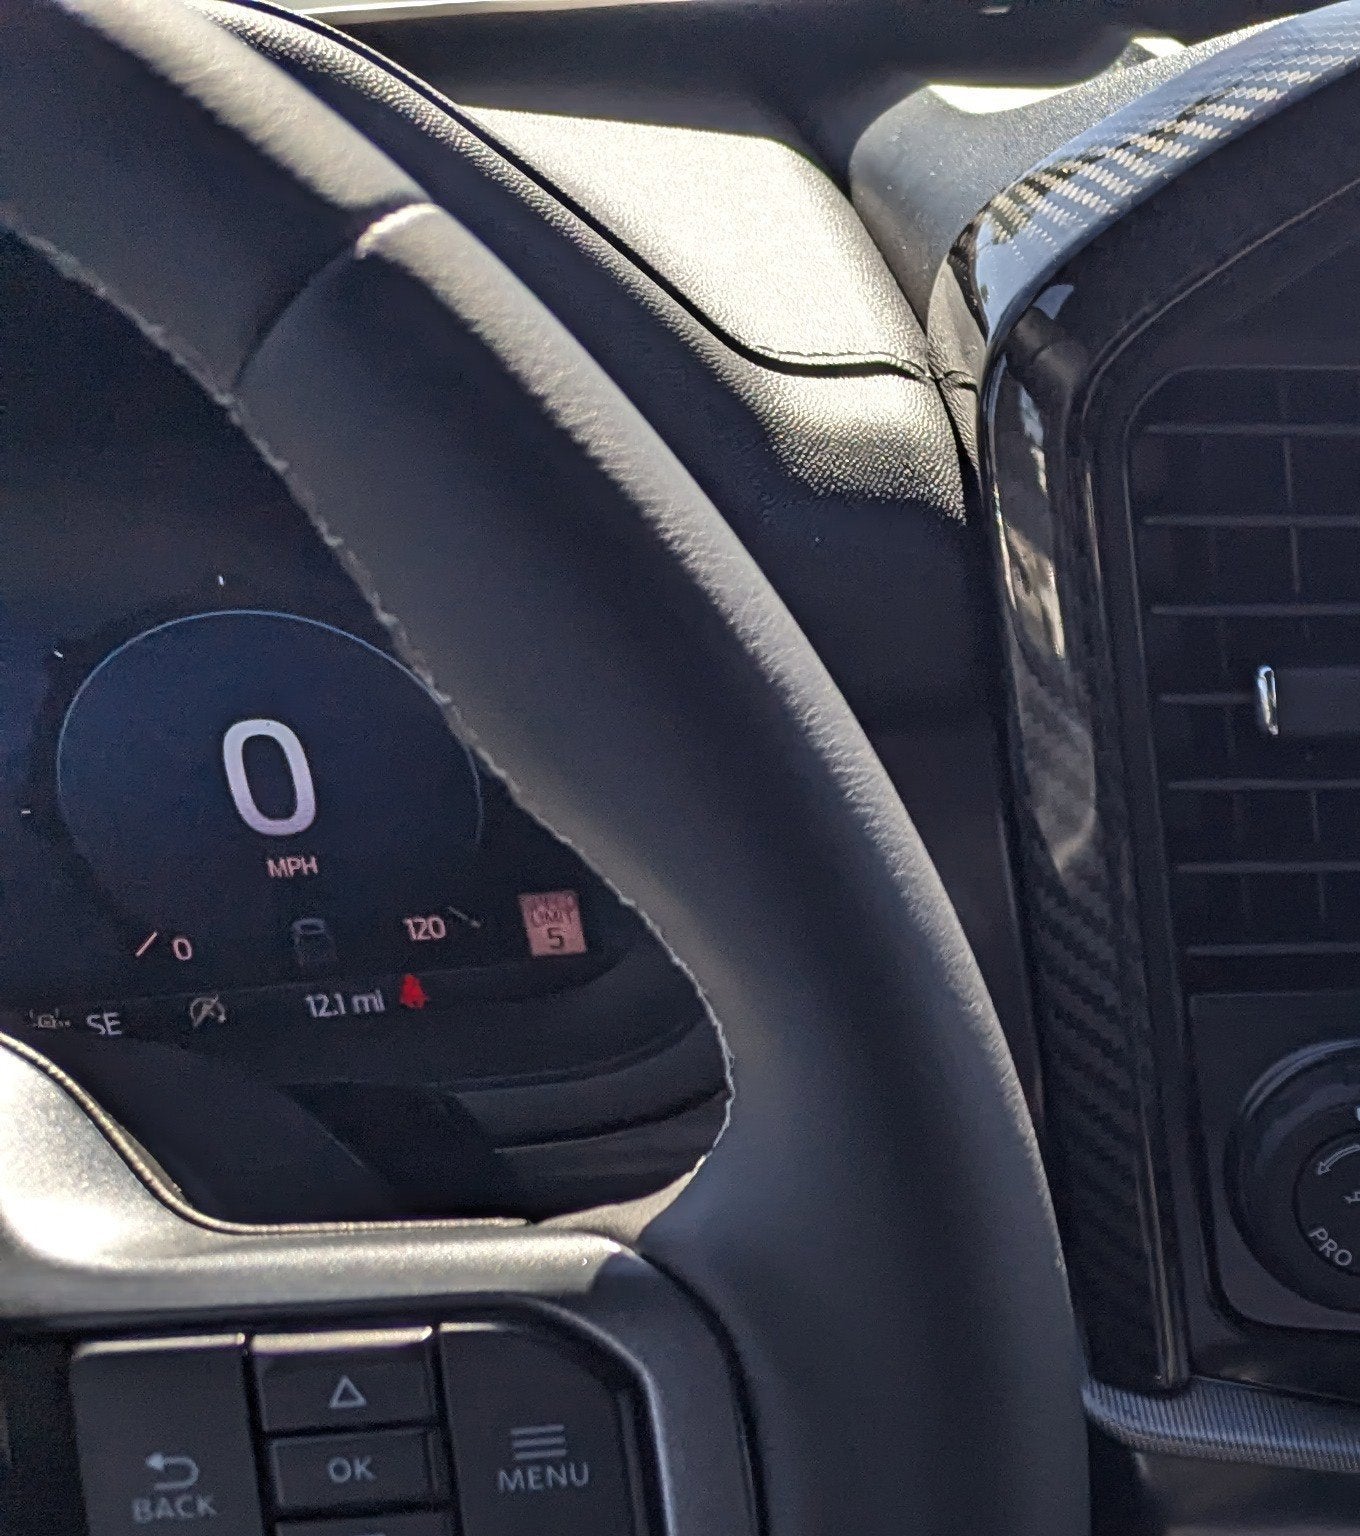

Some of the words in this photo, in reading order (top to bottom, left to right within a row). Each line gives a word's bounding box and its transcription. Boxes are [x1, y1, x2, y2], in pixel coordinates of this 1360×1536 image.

[222, 718, 316, 836] 0
[266, 855, 318, 878] MPH
[403, 915, 447, 941] 120
[547, 927, 565, 949] 5
[172, 936, 193, 961] 0
[86, 1012, 123, 1036] SE
[1308, 1226, 1353, 1267] PRO
[327, 1456, 376, 1483] OK
[498, 1461, 590, 1493] MENU
[132, 1494, 217, 1523] BACK
